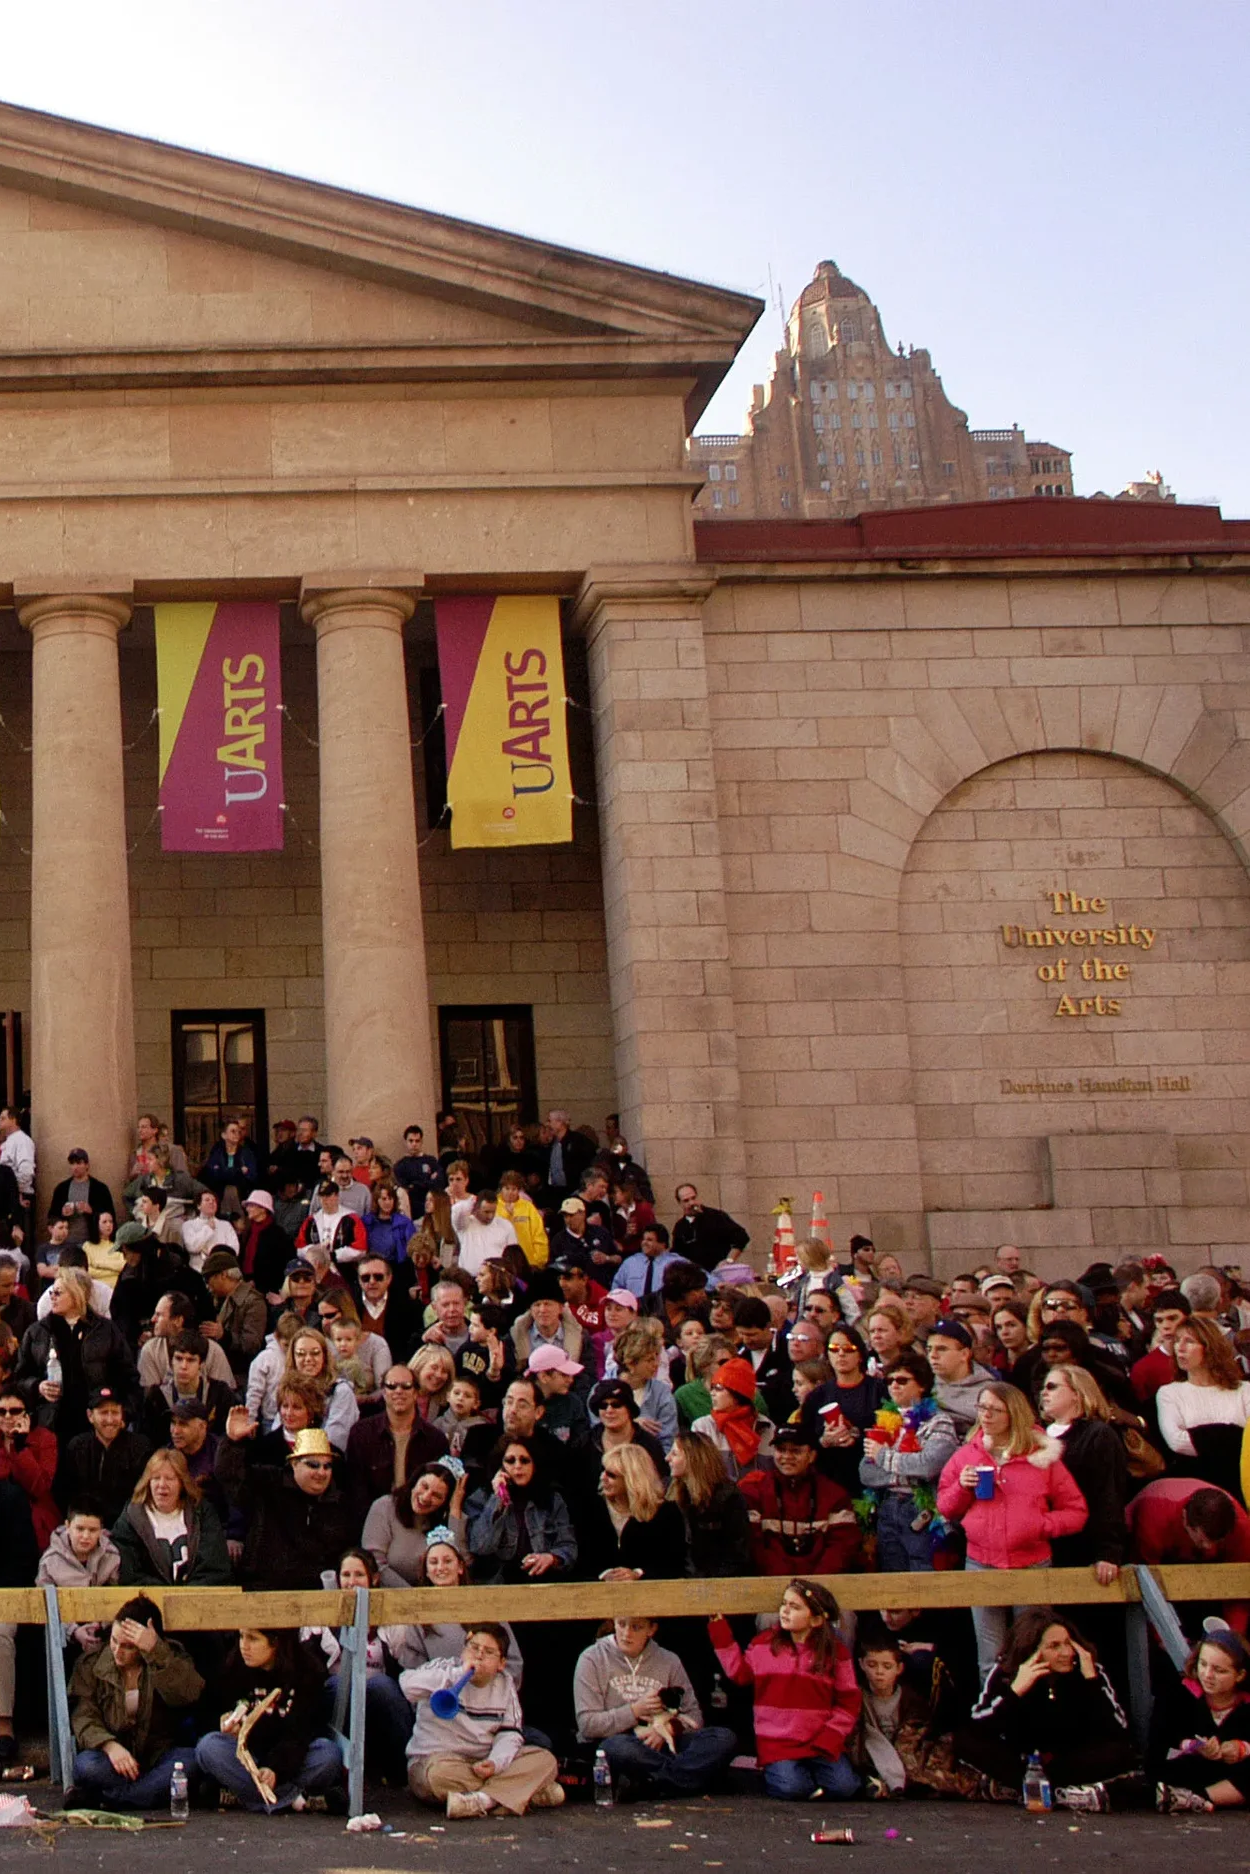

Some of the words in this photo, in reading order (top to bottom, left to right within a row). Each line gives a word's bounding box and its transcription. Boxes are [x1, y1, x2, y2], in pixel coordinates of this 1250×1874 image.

[216, 653, 267, 807] UARTS
[502, 648, 554, 799] UARTS
[1048, 890, 1107, 914] The
[1000, 923, 1156, 949] University
[1038, 958, 1068, 982] of
[1082, 957, 1130, 981] the
[1055, 993, 1122, 1017] Arts
[1000, 1078, 1074, 1095] Dorrance
[1079, 1077, 1152, 1093] Hamilton
[1156, 1075, 1191, 1092] Hall
